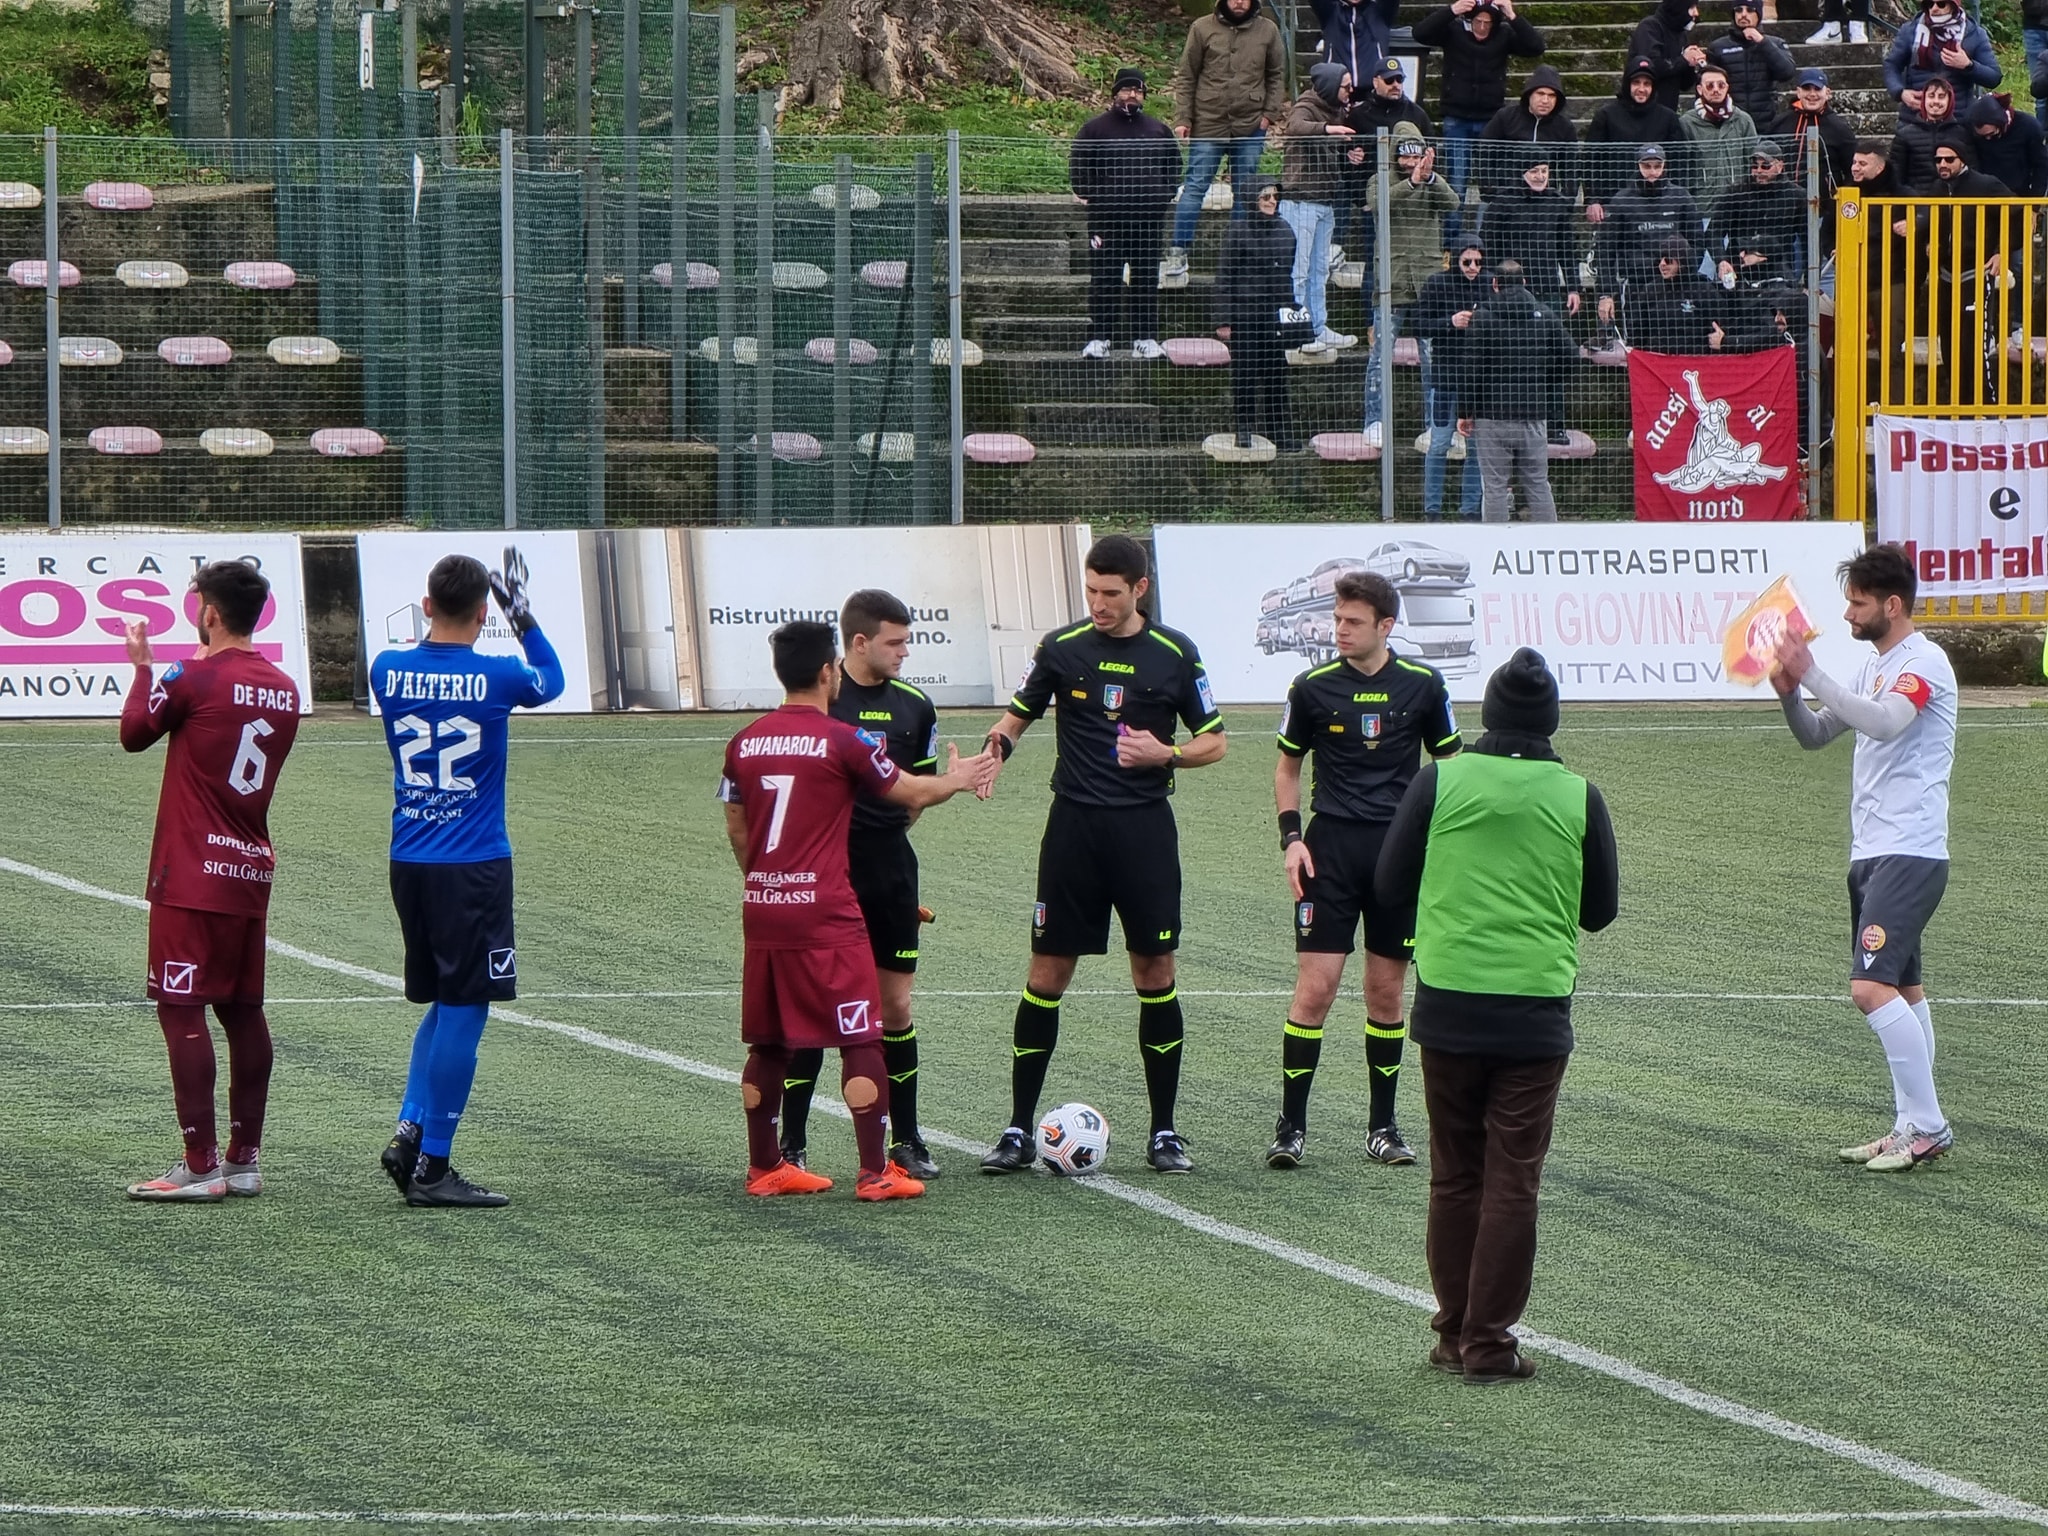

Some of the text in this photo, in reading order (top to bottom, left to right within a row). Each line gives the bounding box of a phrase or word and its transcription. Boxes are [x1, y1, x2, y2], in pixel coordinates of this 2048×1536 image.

[1890, 429, 2048, 473] Passio
[1688, 494, 1744, 520] nord
[1989, 487, 2021, 520] e
[1492, 548, 1769, 575] AUTOTRASPORTI
[1887, 534, 2048, 582] ental
[709, 606, 949, 624] Ristruttura tua
[1555, 591, 1760, 646] GIOVINAZ
[1099, 661, 1136, 675] LEGEA
[1557, 662, 1724, 684] ITTANOV
[233, 683, 293, 712] DE PACE
[385, 669, 487, 702] D'ALTERIO
[1353, 693, 1389, 703] LEGEA
[858, 711, 892, 721] LEGEA
[228, 717, 275, 796] 6
[393, 714, 481, 791] 22
[739, 735, 827, 759] SAVANAROLA
[760, 775, 795, 855] 7
